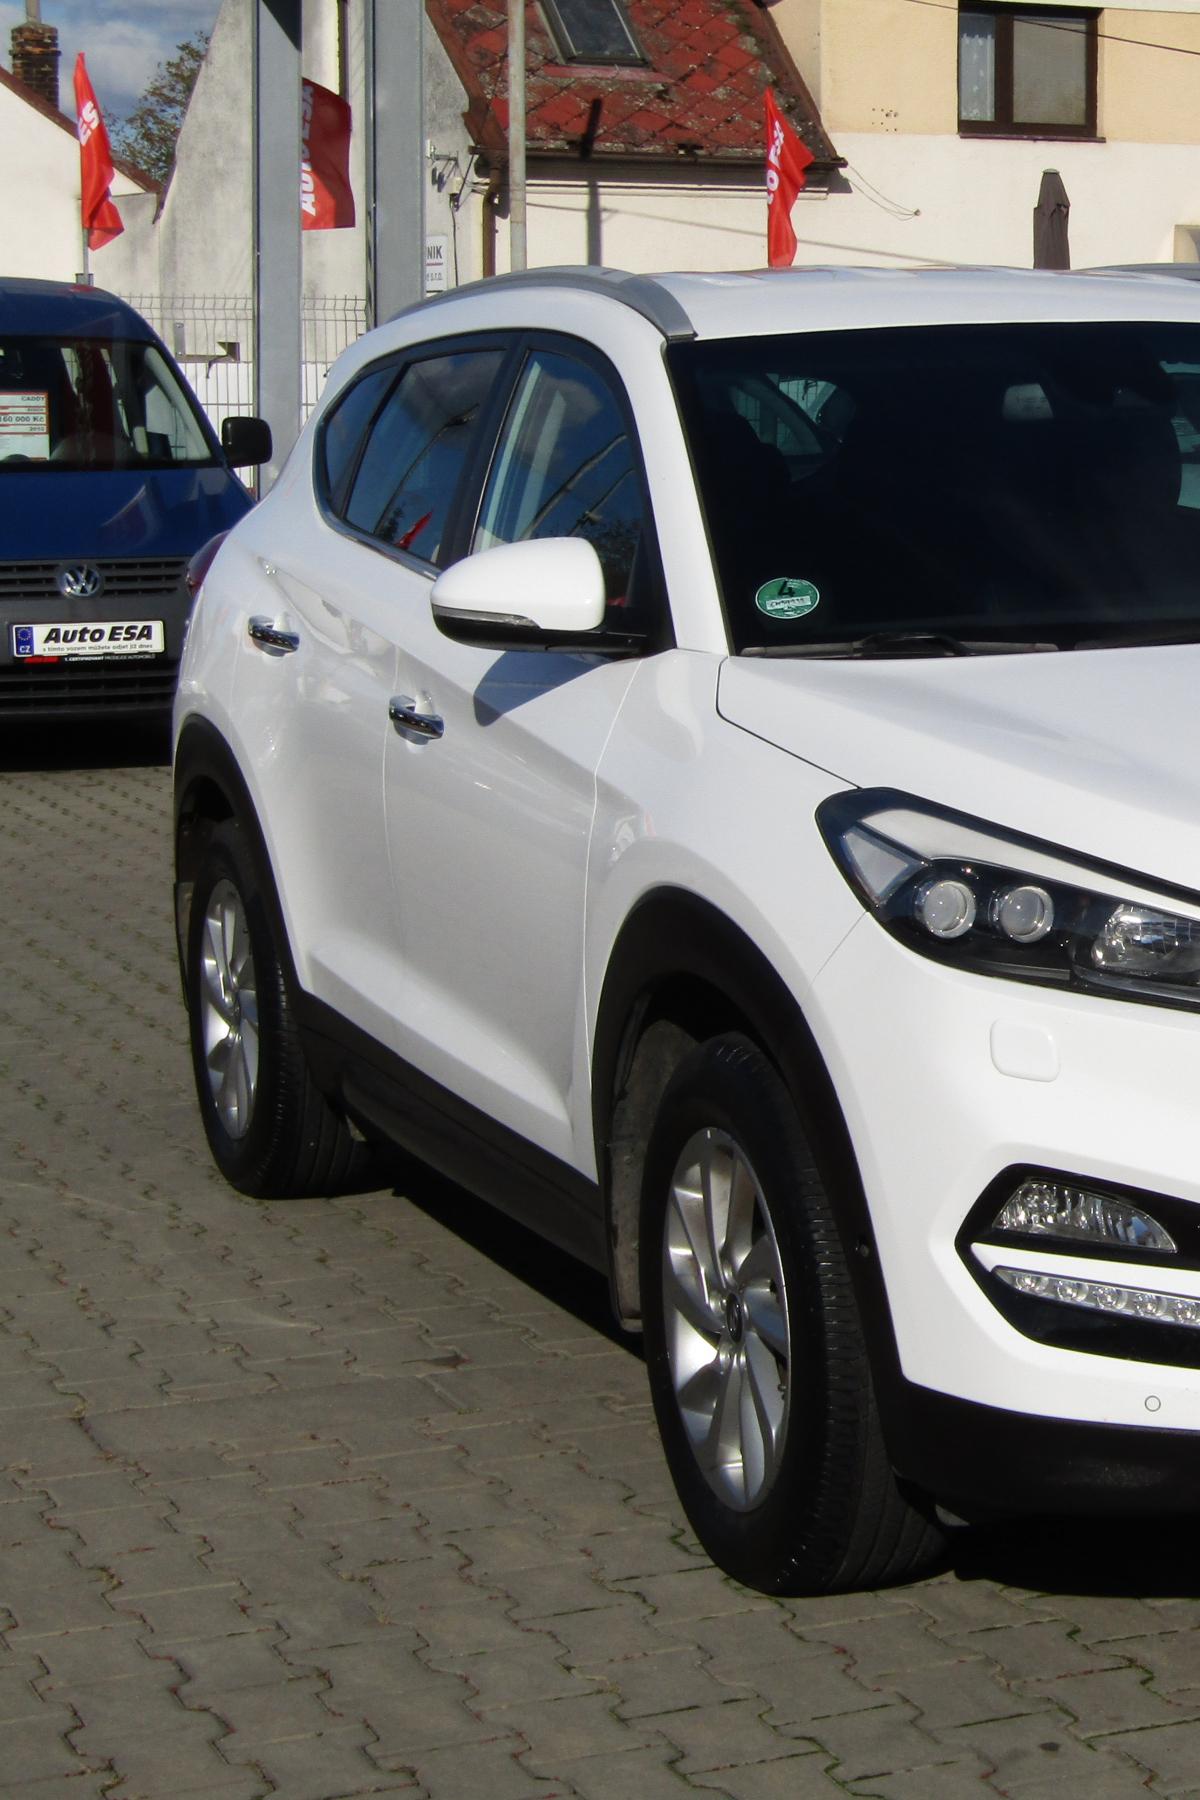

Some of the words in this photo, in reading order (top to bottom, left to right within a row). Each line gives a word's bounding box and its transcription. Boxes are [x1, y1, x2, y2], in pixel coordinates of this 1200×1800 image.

[778, 580, 795, 597] 4
[44, 626, 106, 644] Auto
[108, 625, 153, 642] ESA
[19, 645, 31, 653] CZ
